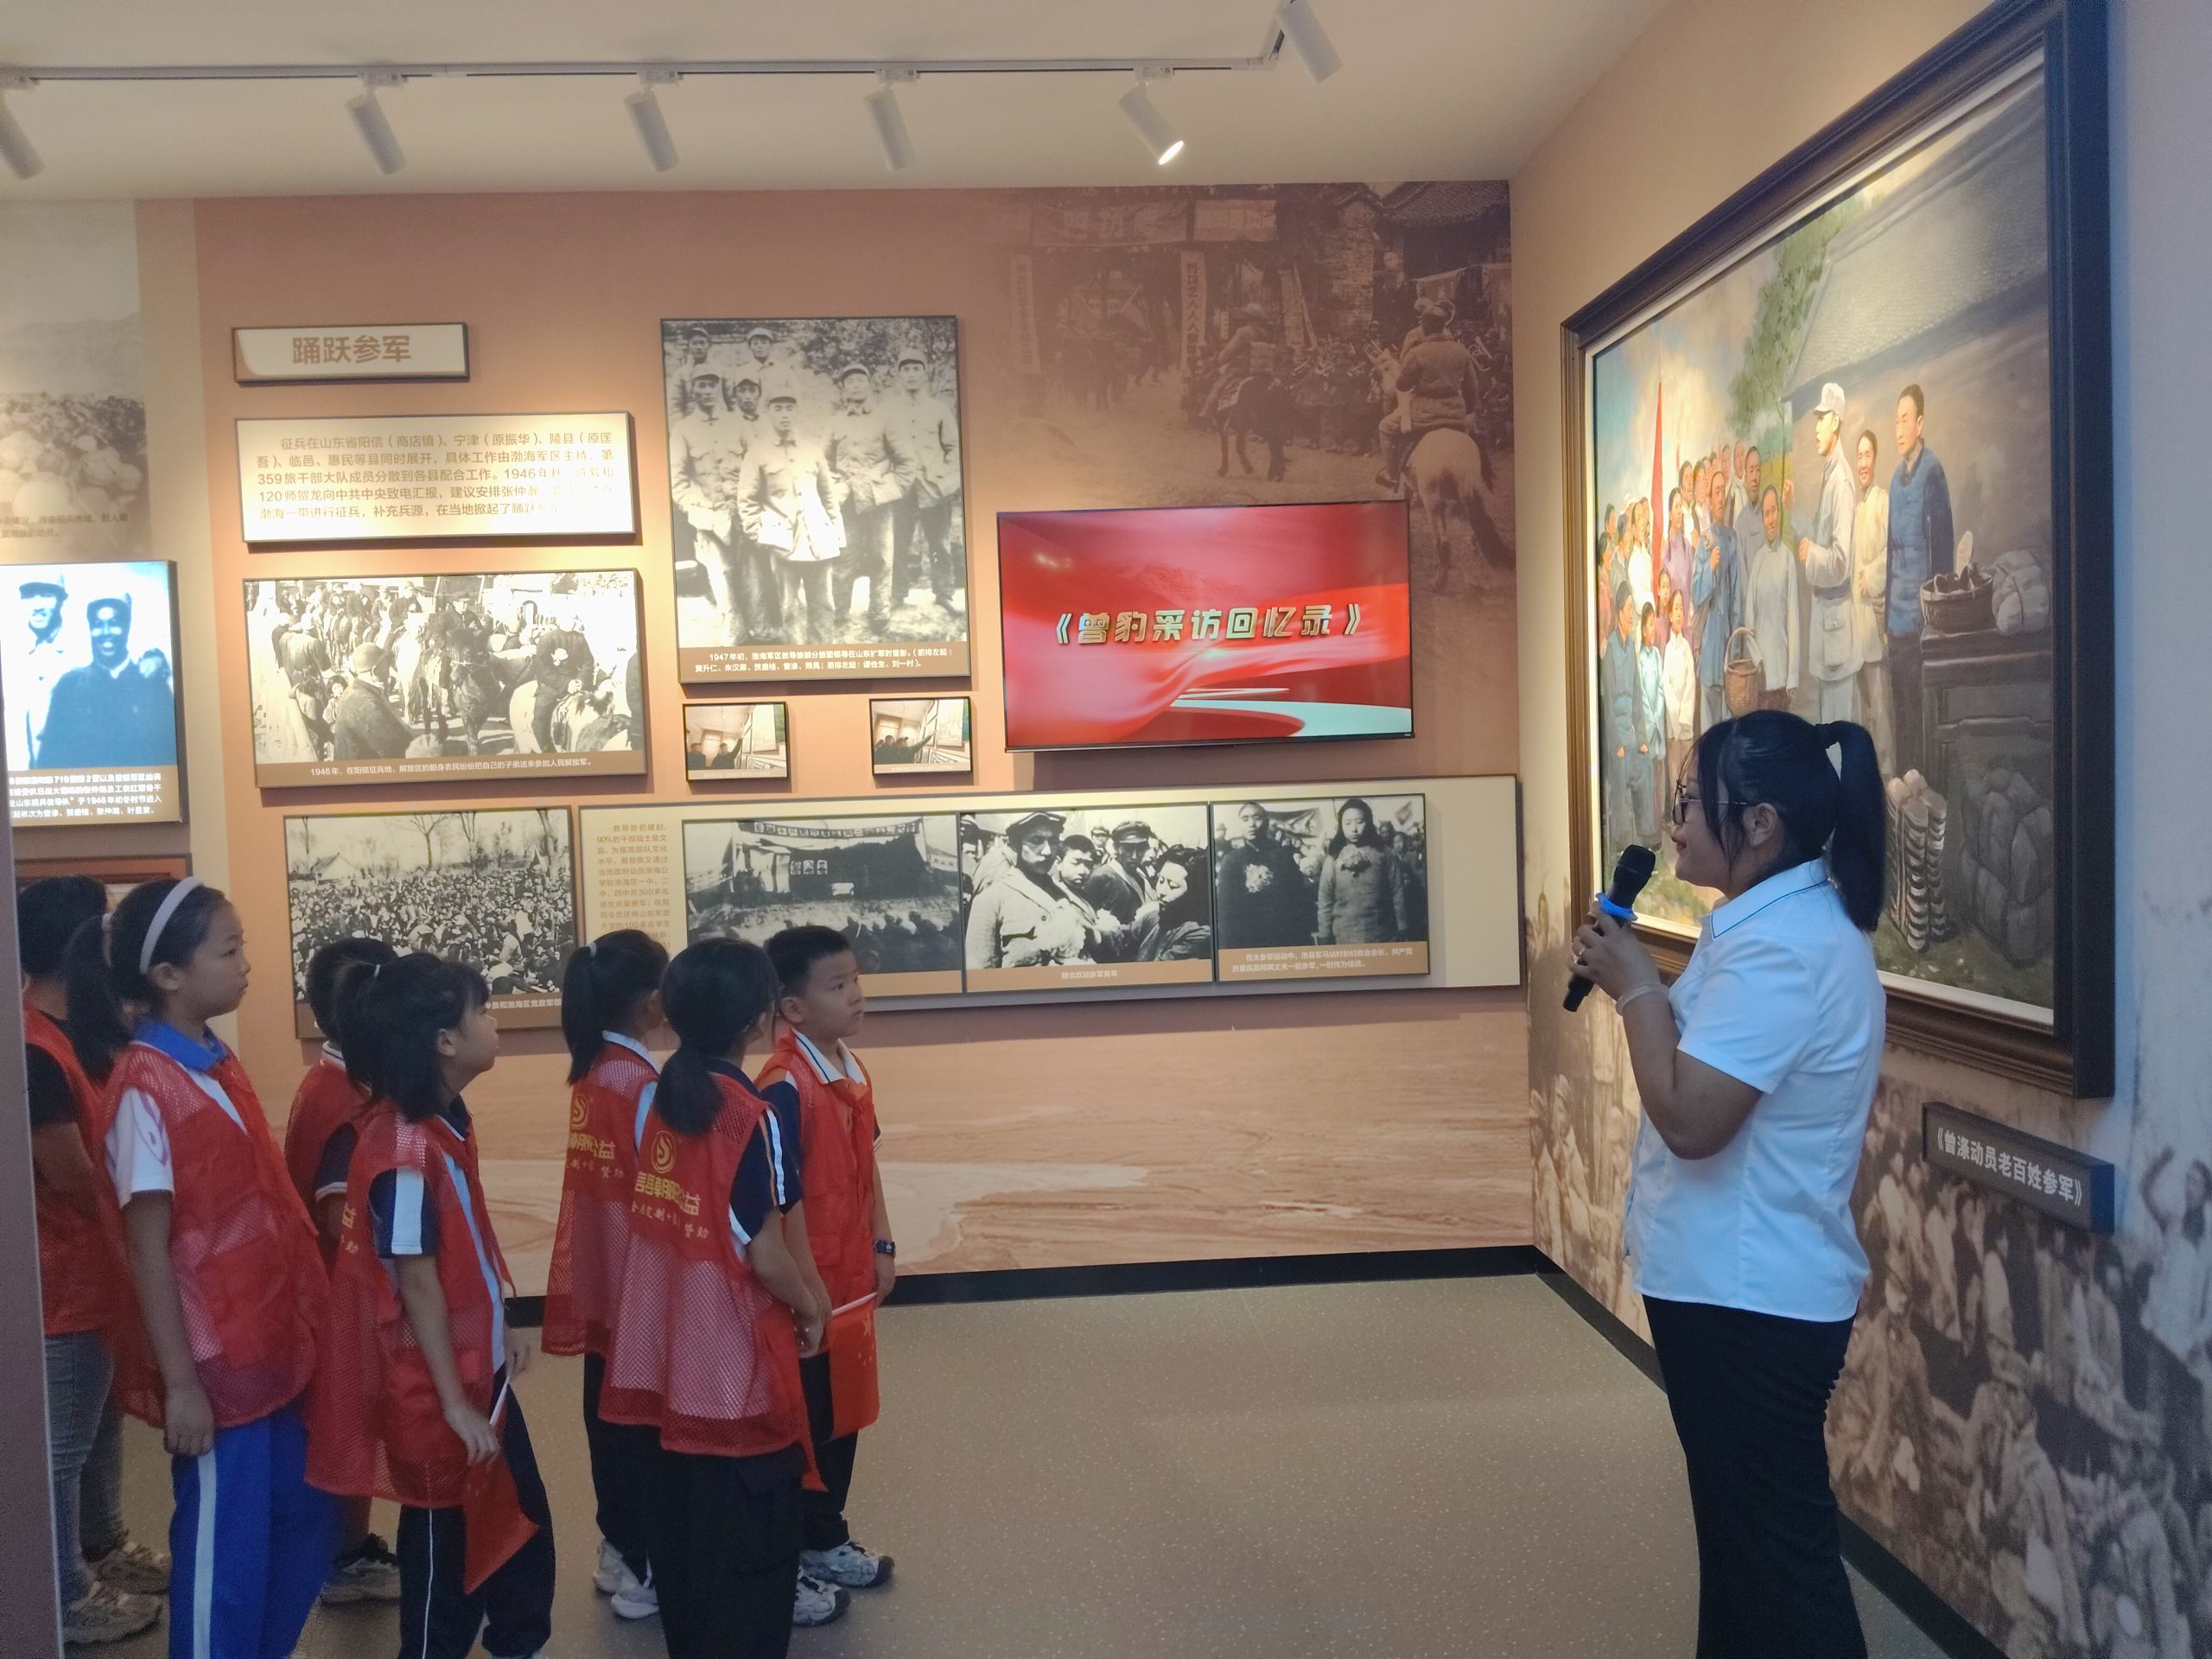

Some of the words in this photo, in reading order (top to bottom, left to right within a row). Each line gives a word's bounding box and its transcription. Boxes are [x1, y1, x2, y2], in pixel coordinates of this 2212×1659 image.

[291, 334, 412, 365] 踊跃参军
[1056, 603, 1362, 645] 《曾豹采访回忆录》
[1937, 1127, 2082, 1206] 《曾涤动员老百姓参军》
